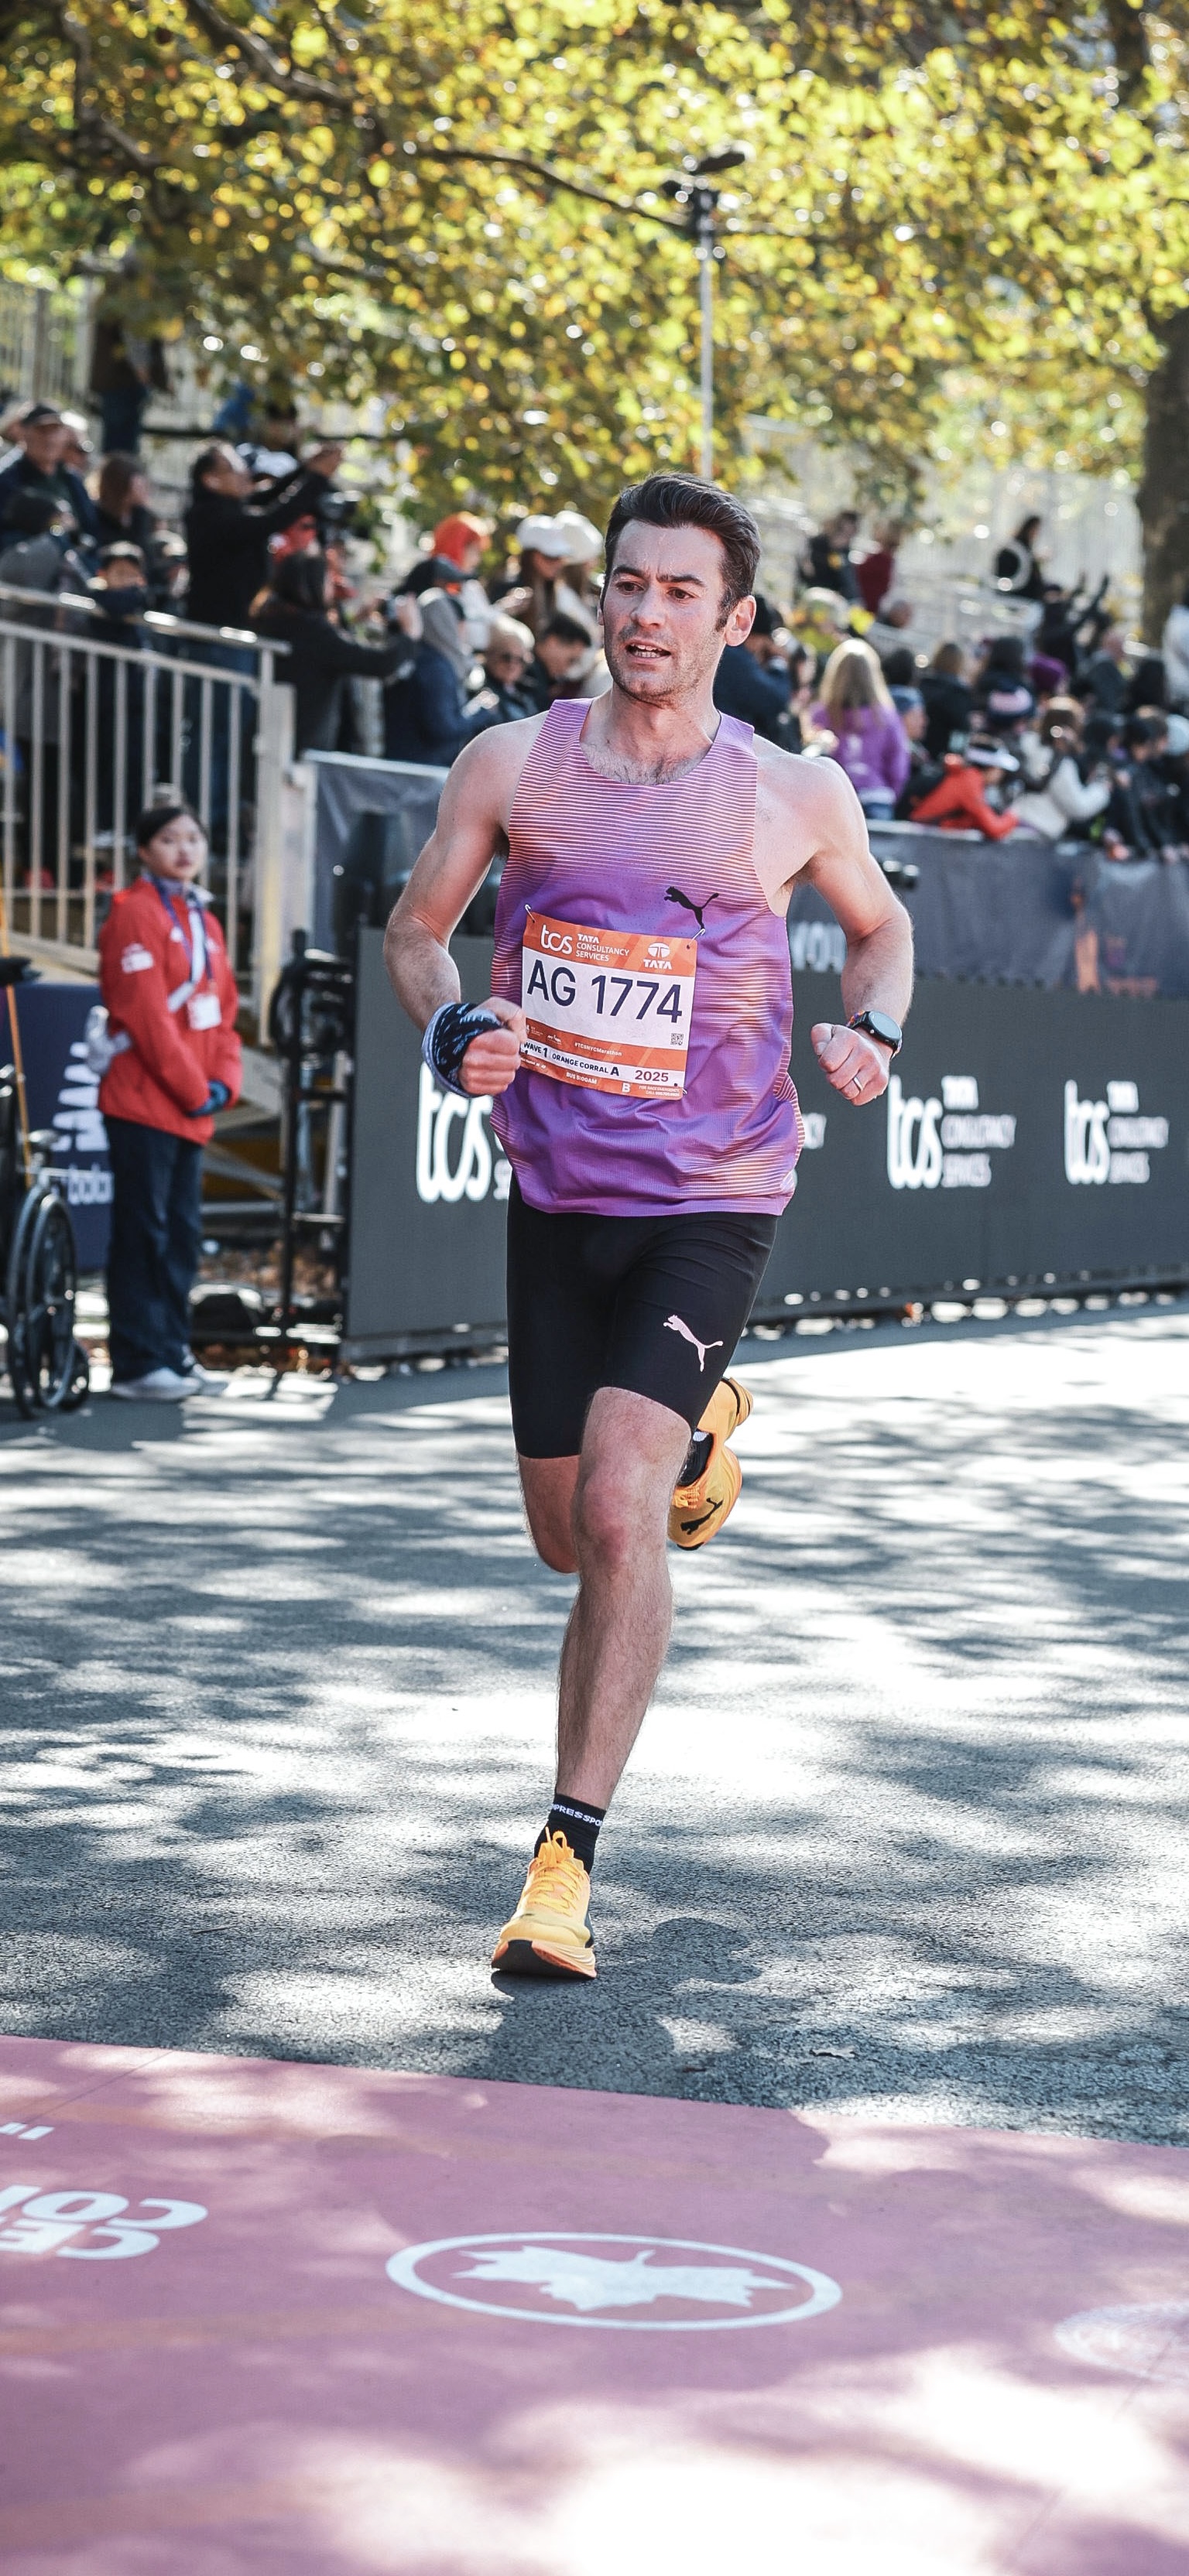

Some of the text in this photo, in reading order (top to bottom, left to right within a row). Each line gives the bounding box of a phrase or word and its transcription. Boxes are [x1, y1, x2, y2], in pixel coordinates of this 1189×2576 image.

[540, 924, 573, 955] tcs
[576, 942, 630, 956] CONSULTANCY
[577, 933, 600, 943] TATA
[575, 951, 609, 962] SERVICES
[643, 959, 672, 970] TATA
[527, 959, 682, 1024] AG 1774
[523, 1042, 542, 1053] WAVE
[543, 1047, 548, 1058] 1
[552, 1053, 578, 1066] ORANGE
[579, 1062, 609, 1073] CORRAL
[610, 1066, 619, 1076] A
[635, 1069, 669, 1082] 2025
[622, 1083, 630, 1093] B
[416, 1062, 493, 1202] tcs
[887, 1074, 943, 1189] tcs
[0, 2218, 160, 2260] CE
